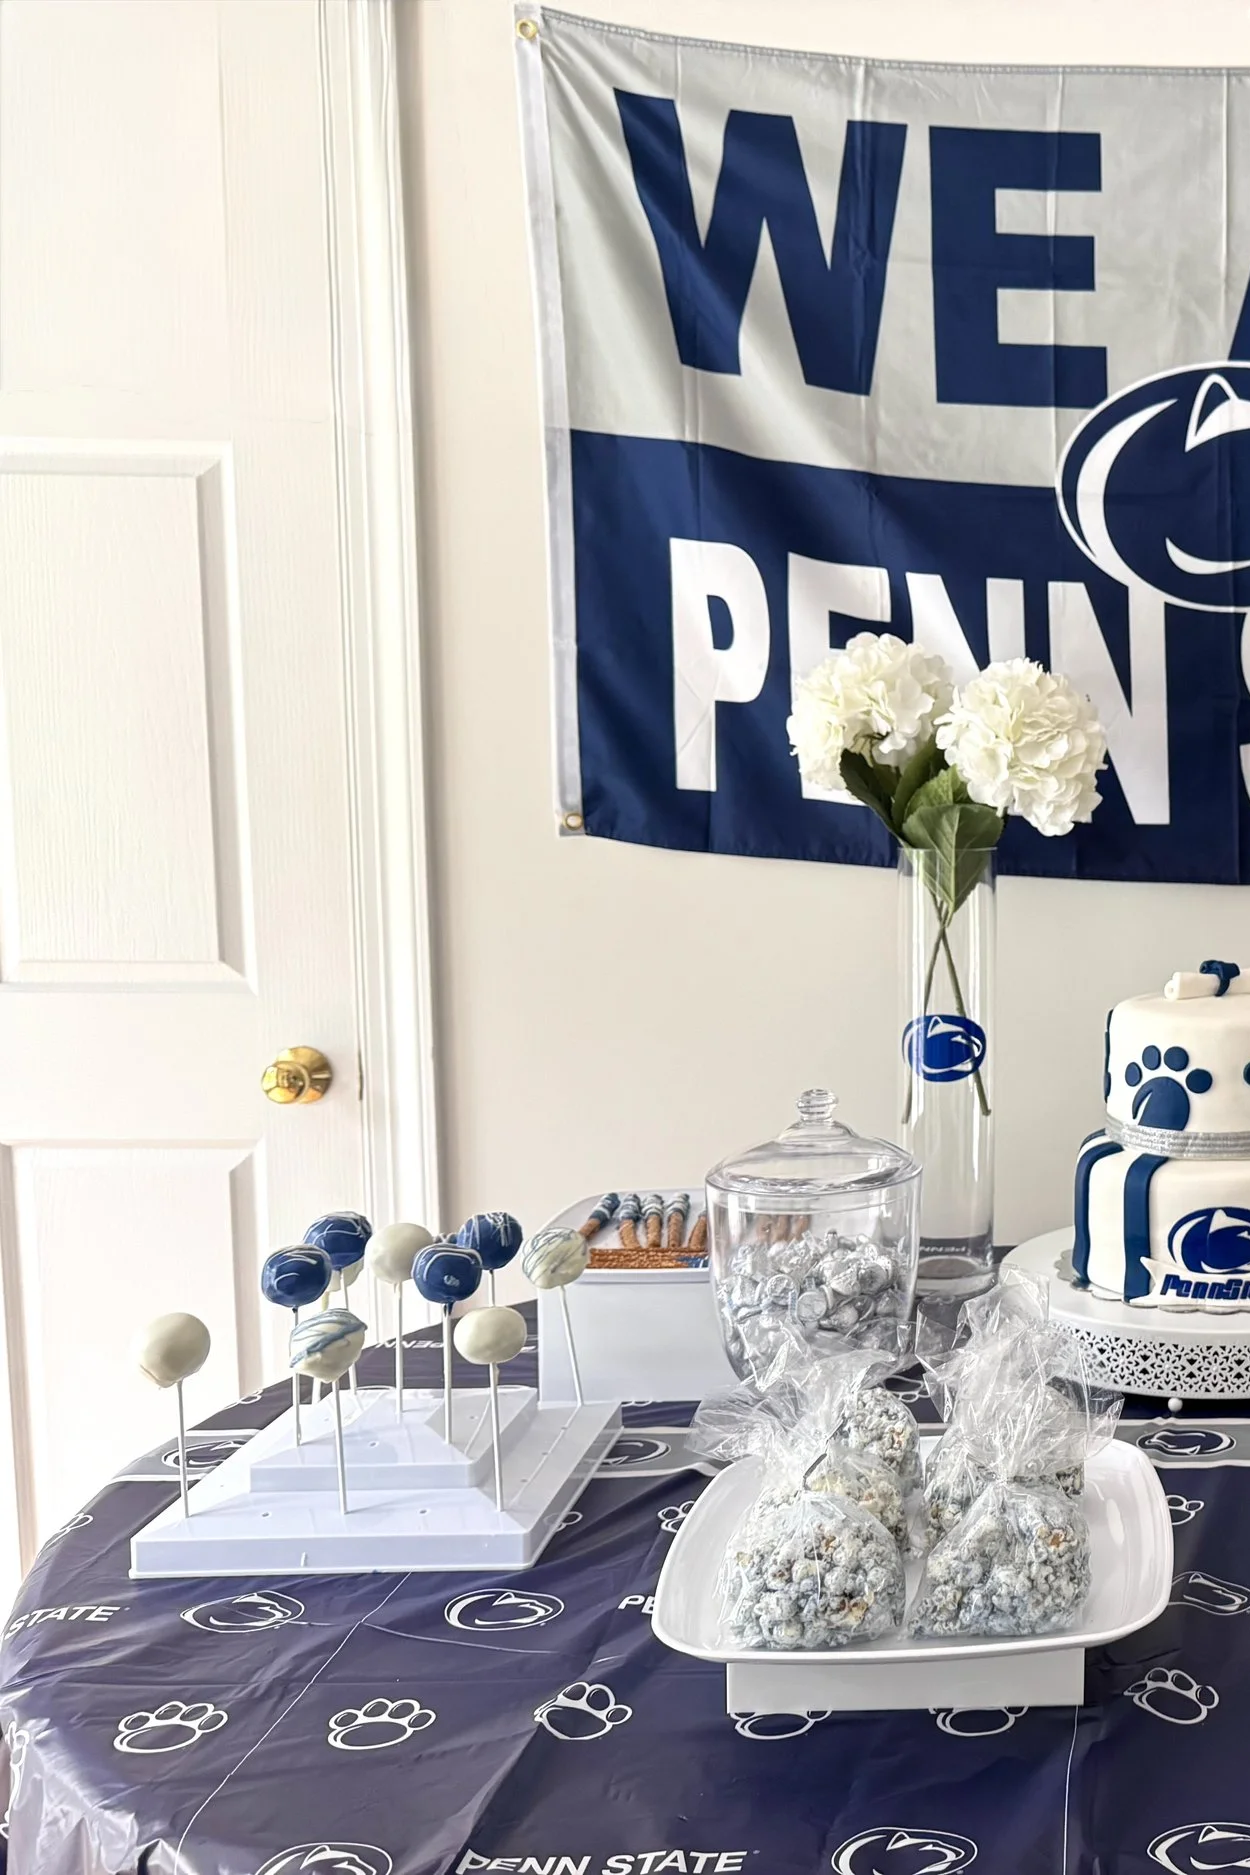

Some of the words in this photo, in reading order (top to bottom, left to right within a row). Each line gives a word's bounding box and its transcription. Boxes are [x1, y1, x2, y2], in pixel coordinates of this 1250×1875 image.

[612, 87, 1108, 410] WE
[4, 1605, 122, 1640] STATE
[455, 1848, 592, 1875] PENN
[601, 1849, 748, 1875] STATE
